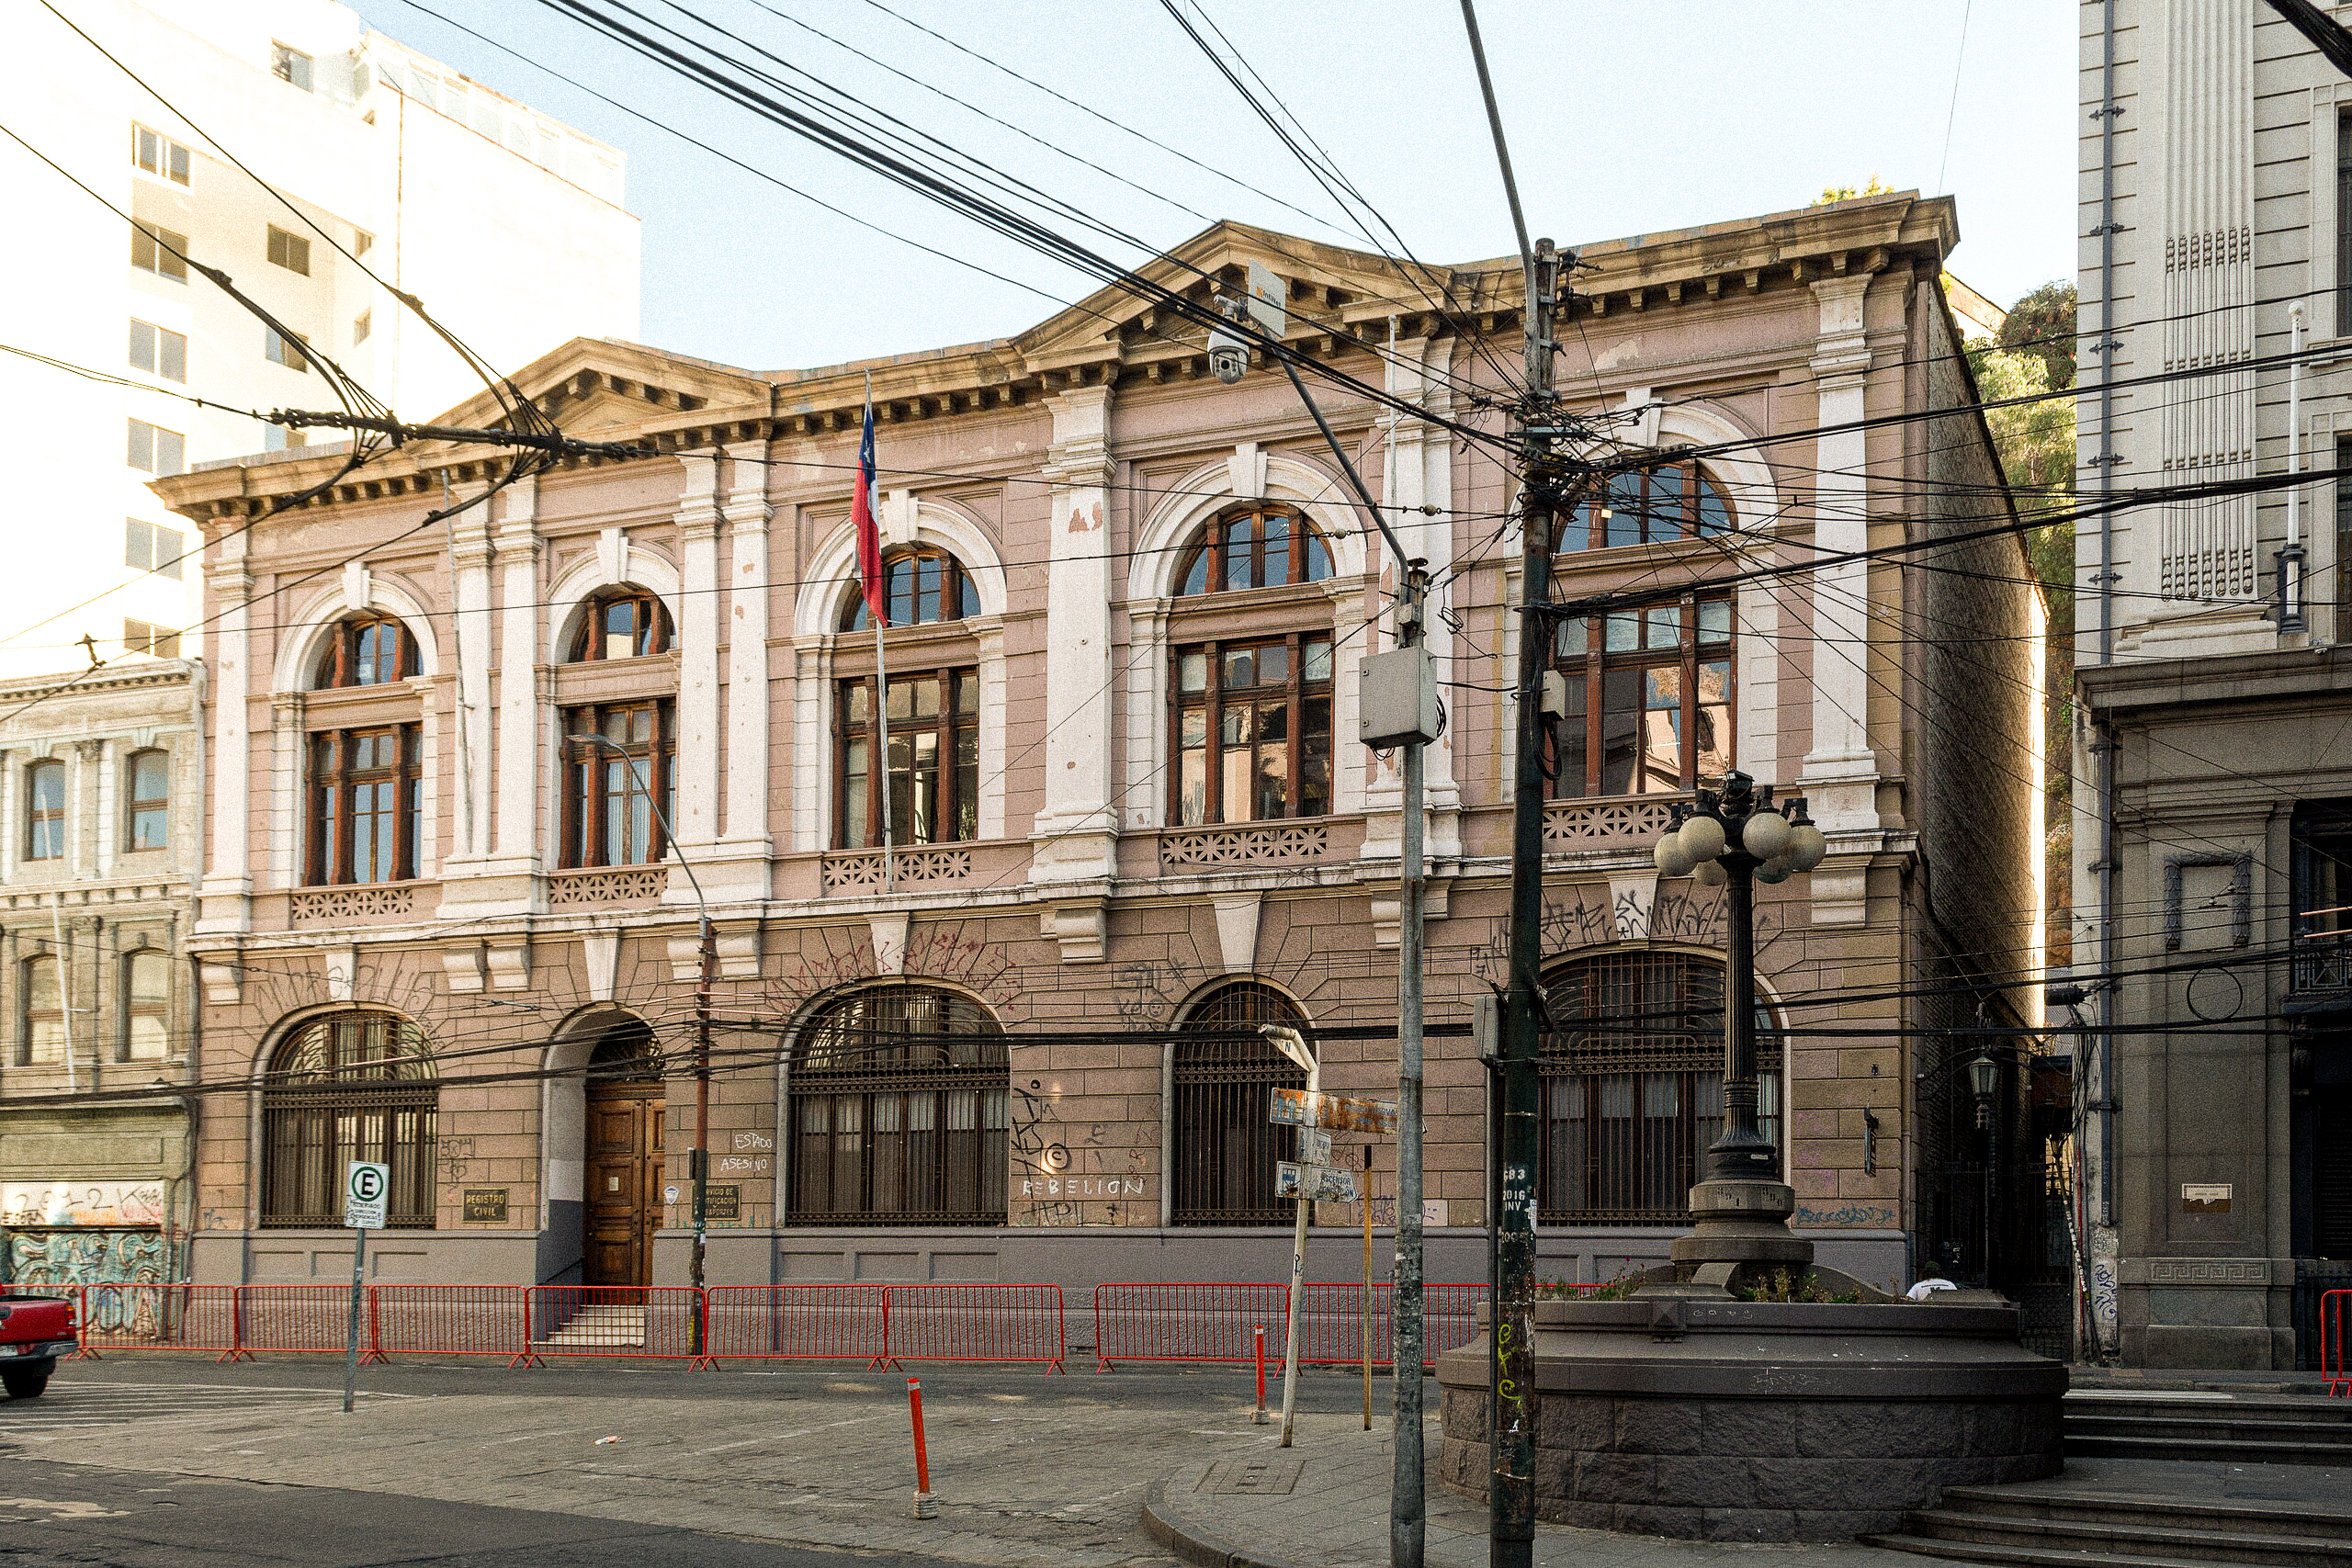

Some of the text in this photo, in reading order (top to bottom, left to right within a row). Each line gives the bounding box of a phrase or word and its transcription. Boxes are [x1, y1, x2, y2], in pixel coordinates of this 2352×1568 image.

[734, 1132, 773, 1149] ESTADO
[720, 1158, 767, 1172] ASESINO
[361, 1172, 375, 1196] E
[1023, 1179, 1145, 1195] REBELION
[466, 1194, 504, 1204] REGISTRO
[474, 1207, 496, 1216] CIVIL
